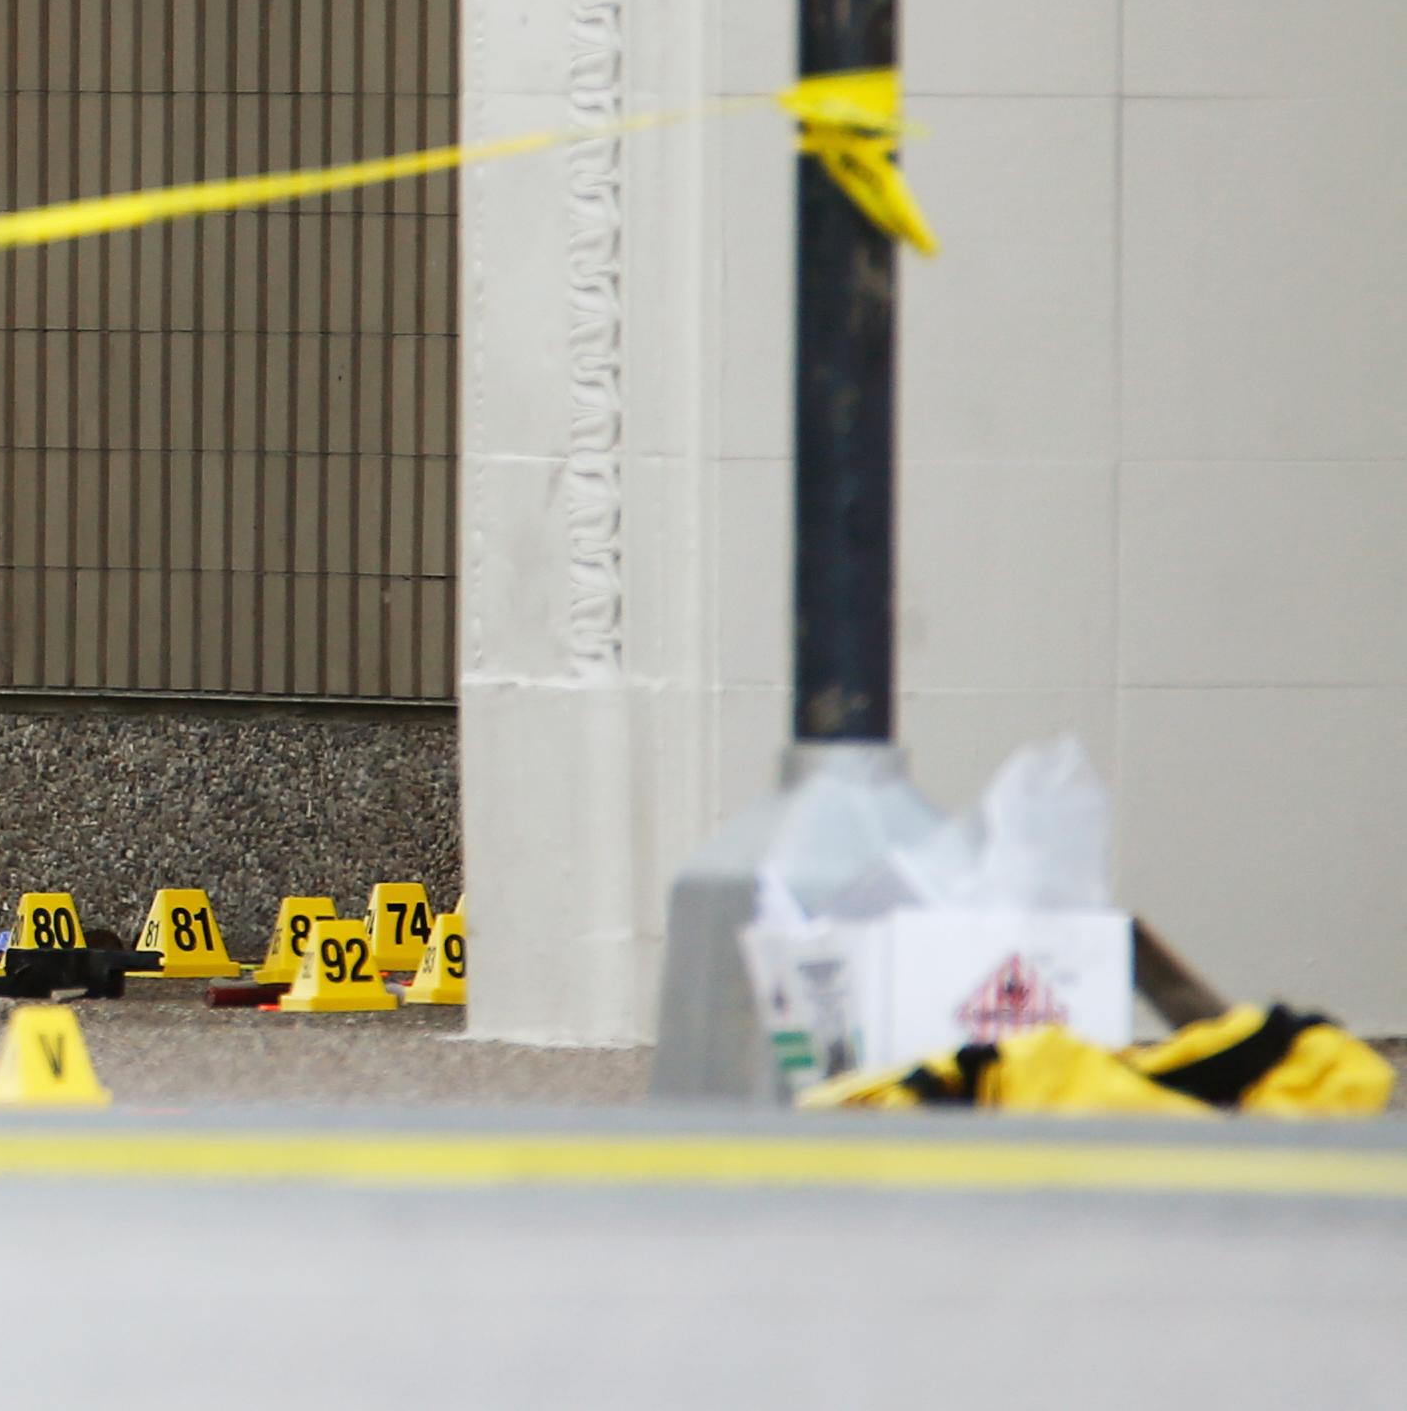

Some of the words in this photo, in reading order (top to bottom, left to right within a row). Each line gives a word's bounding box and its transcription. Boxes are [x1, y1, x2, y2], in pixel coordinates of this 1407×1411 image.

[33, 907, 76, 949] 80
[171, 907, 214, 952] 81
[386, 902, 431, 945] 74
[321, 938, 374, 983] 92
[38, 1033, 65, 1079] V
